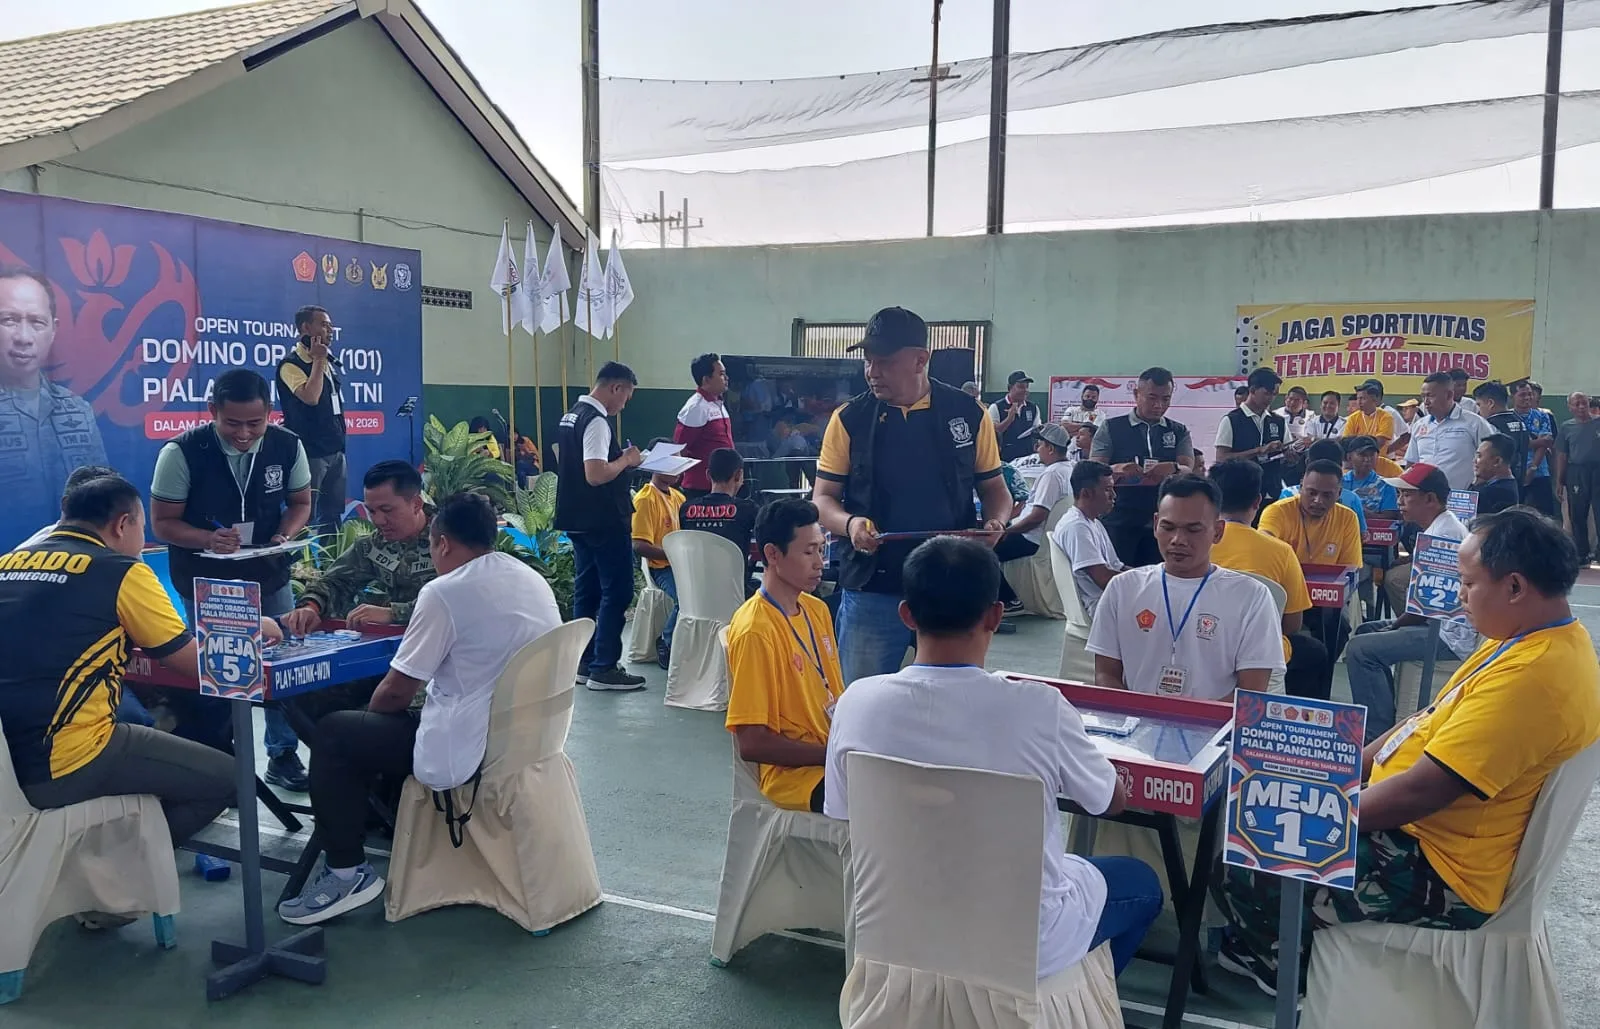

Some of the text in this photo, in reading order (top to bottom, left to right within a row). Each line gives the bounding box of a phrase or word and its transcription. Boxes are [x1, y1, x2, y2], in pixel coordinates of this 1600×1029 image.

[195, 317, 342, 341] OPEN TOURNAT
[1277, 313, 1486, 345] JAGA SPORTIVITAS
[1359, 337, 1396, 350] DAN
[142, 338, 246, 366] DOMINO
[340, 348, 382, 376] (101)
[1274, 351, 1489, 379] TETAPLAH BERNAFAS
[143, 378, 215, 402] PIALA
[350, 382, 383, 403] TNI
[153, 420, 196, 432] DALAM
[356, 418, 378, 428] 2026
[686, 504, 737, 519] ORADO
[375, 553, 394, 567] EDY
[415, 561, 429, 570] TNI
[1311, 588, 1339, 601] ORADO
[1419, 575, 1461, 592] MEJA
[1429, 589, 1446, 608] 2
[207, 636, 256, 660] MEJA
[222, 655, 240, 682] 5
[1241, 726, 1356, 754] DOMINO ORADO (101)
[1260, 721, 1338, 739] OPEN TOURNAMENT
[1240, 737, 1356, 765] PIALA PANGLIMA TNI
[1144, 776, 1194, 805] ORADO
[1246, 780, 1344, 824] MEJA
[1273, 812, 1307, 857] 1
